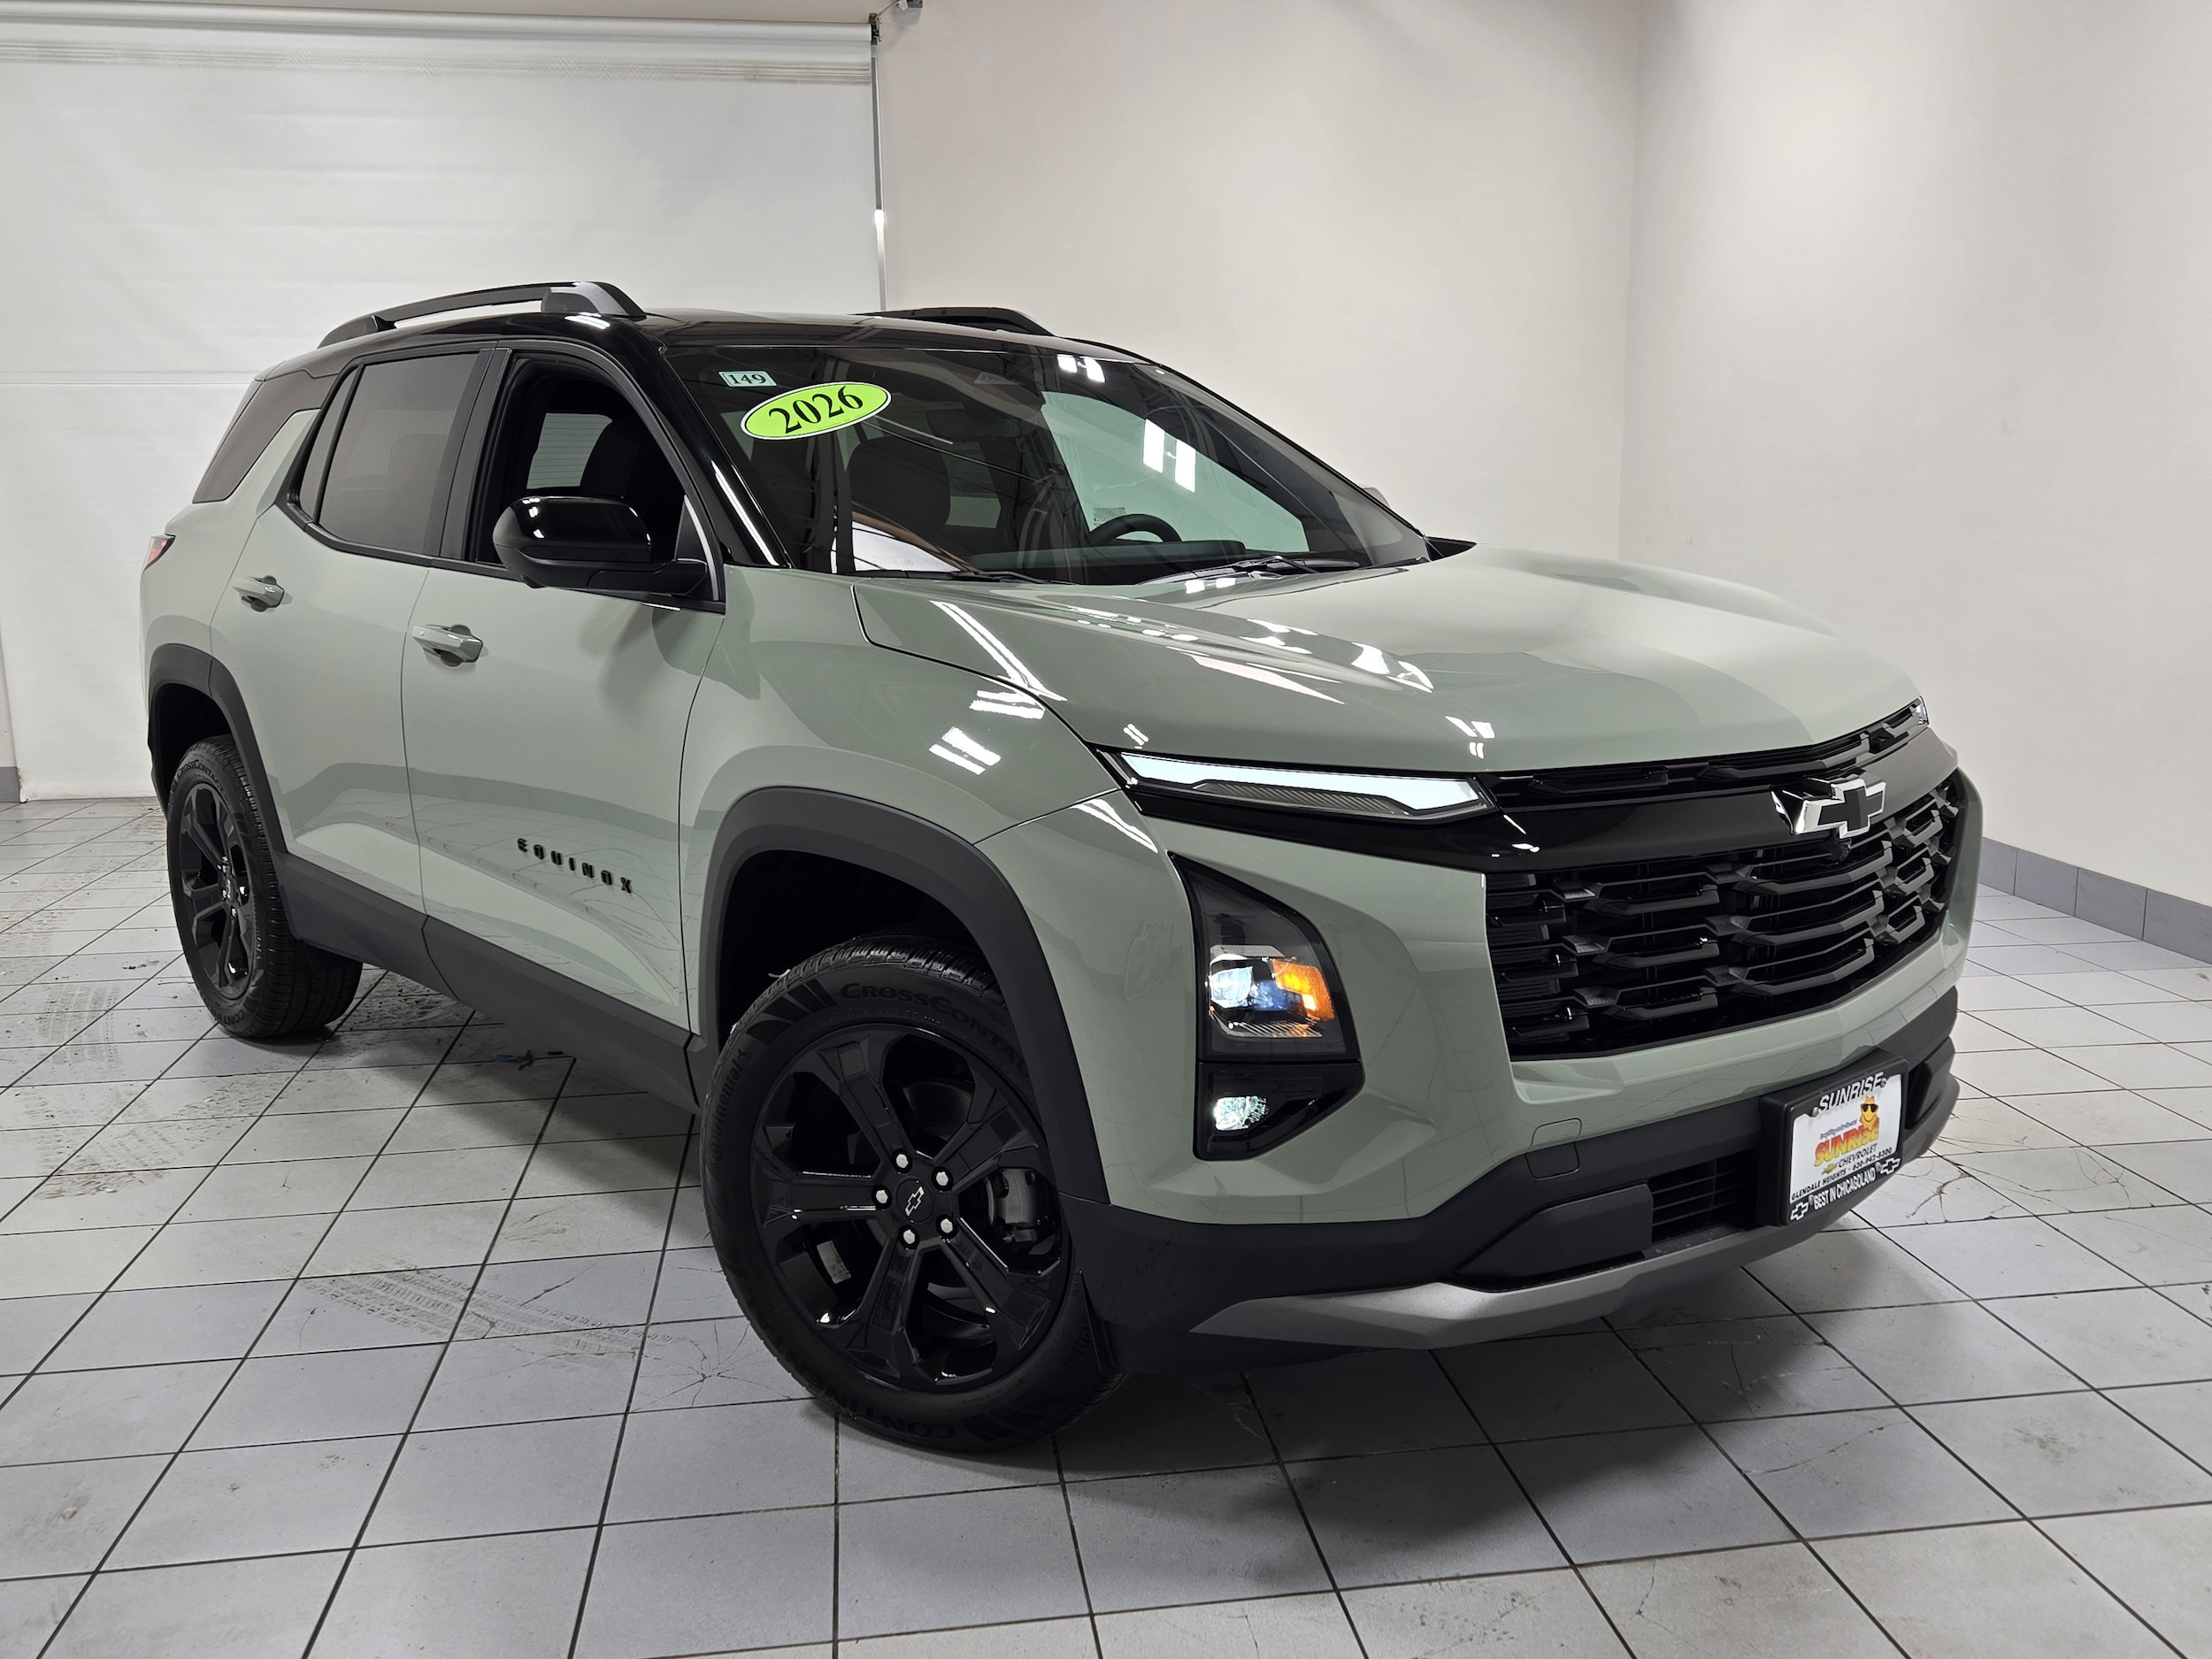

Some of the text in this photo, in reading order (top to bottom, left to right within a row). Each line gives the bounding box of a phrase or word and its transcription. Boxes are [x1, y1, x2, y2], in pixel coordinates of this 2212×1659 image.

[728, 373, 766, 385] 149
[768, 386, 864, 434] 2026
[517, 838, 633, 894] EQUINOX
[840, 981, 1029, 1077] CROSSCONTAC
[1818, 1071, 1885, 1112] SUNRISE
[1814, 1121, 1879, 1167] SUNRISE
[1839, 1143, 1878, 1168] CHEVROLET
[1791, 1179, 1821, 1201] GLENDALE
[1822, 1167, 1847, 1186] HEIGHTS
[1813, 1167, 1877, 1210] BEST IN CHICAGOLAND
